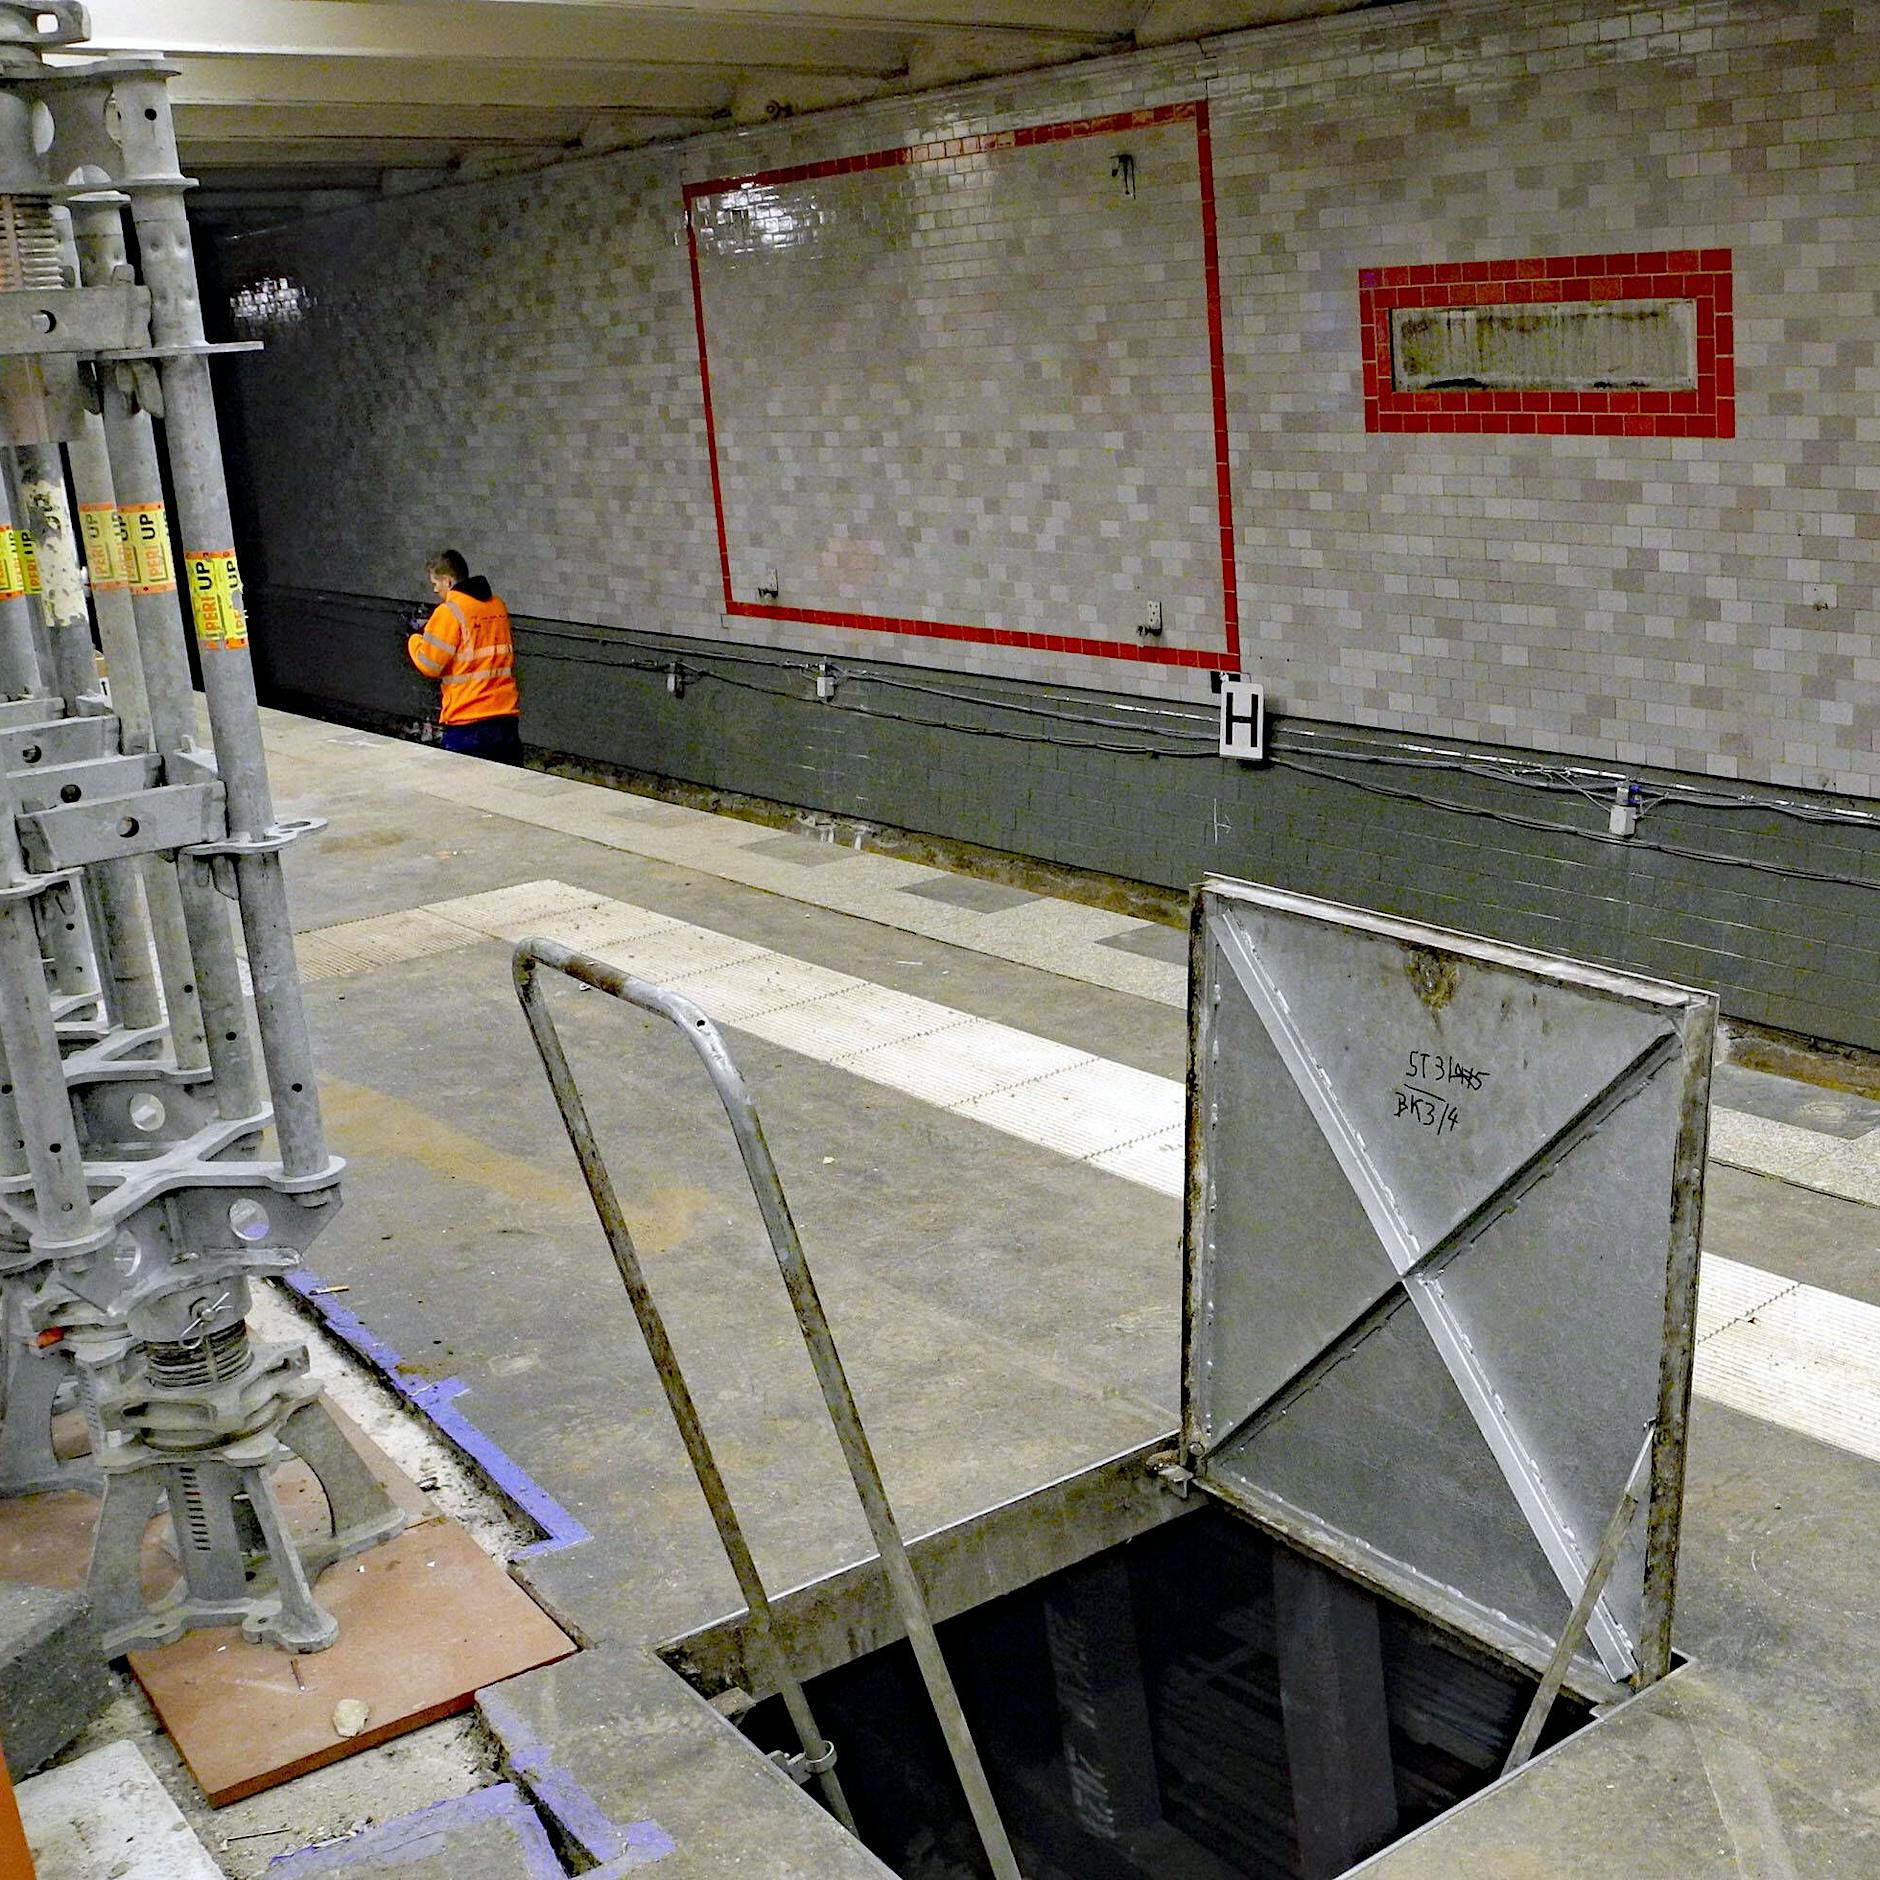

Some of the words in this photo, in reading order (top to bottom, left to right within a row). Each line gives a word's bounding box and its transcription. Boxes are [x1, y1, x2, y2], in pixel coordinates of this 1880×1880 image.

[85, 513, 99, 539] UP
[140, 513, 155, 540] UP
[145, 545, 164, 577] PERI
[196, 561, 213, 590] UP
[227, 560, 239, 589] UP
[200, 596, 219, 631] PERI
[1225, 692, 1258, 748] H
